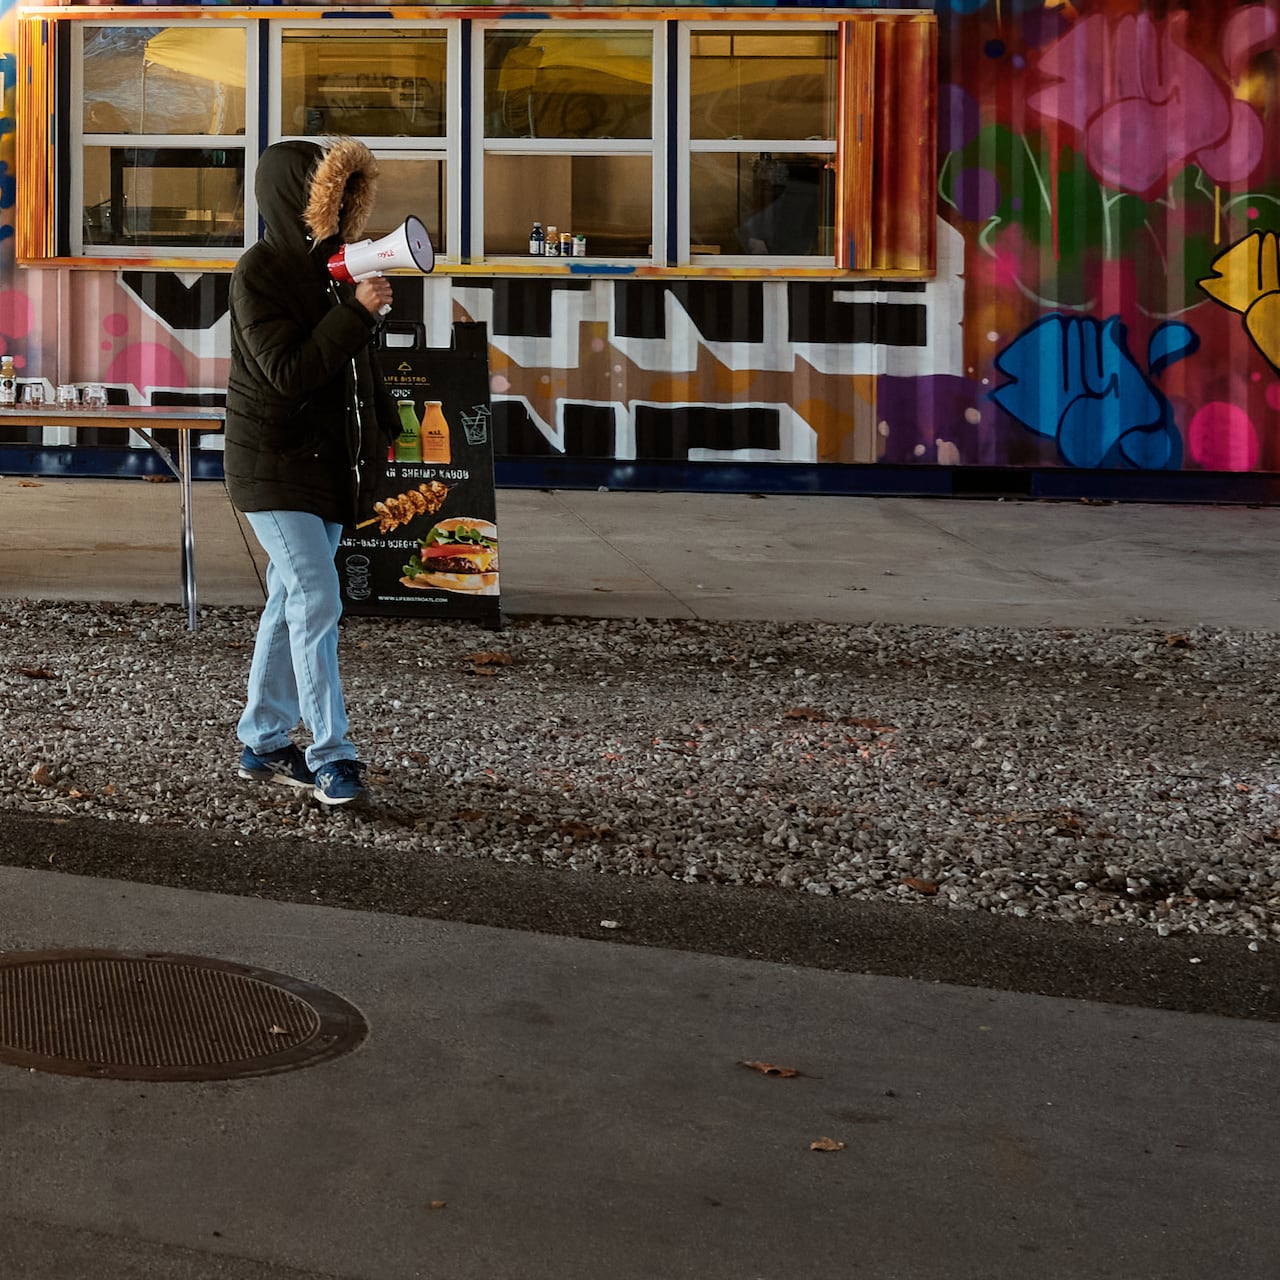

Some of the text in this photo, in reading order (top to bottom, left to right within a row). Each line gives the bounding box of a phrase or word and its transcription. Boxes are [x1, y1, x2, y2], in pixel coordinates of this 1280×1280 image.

[401, 467, 437, 479] SHRIMP
[438, 468, 470, 480] KABOB
[338, 538, 386, 549] LANT-BASED
